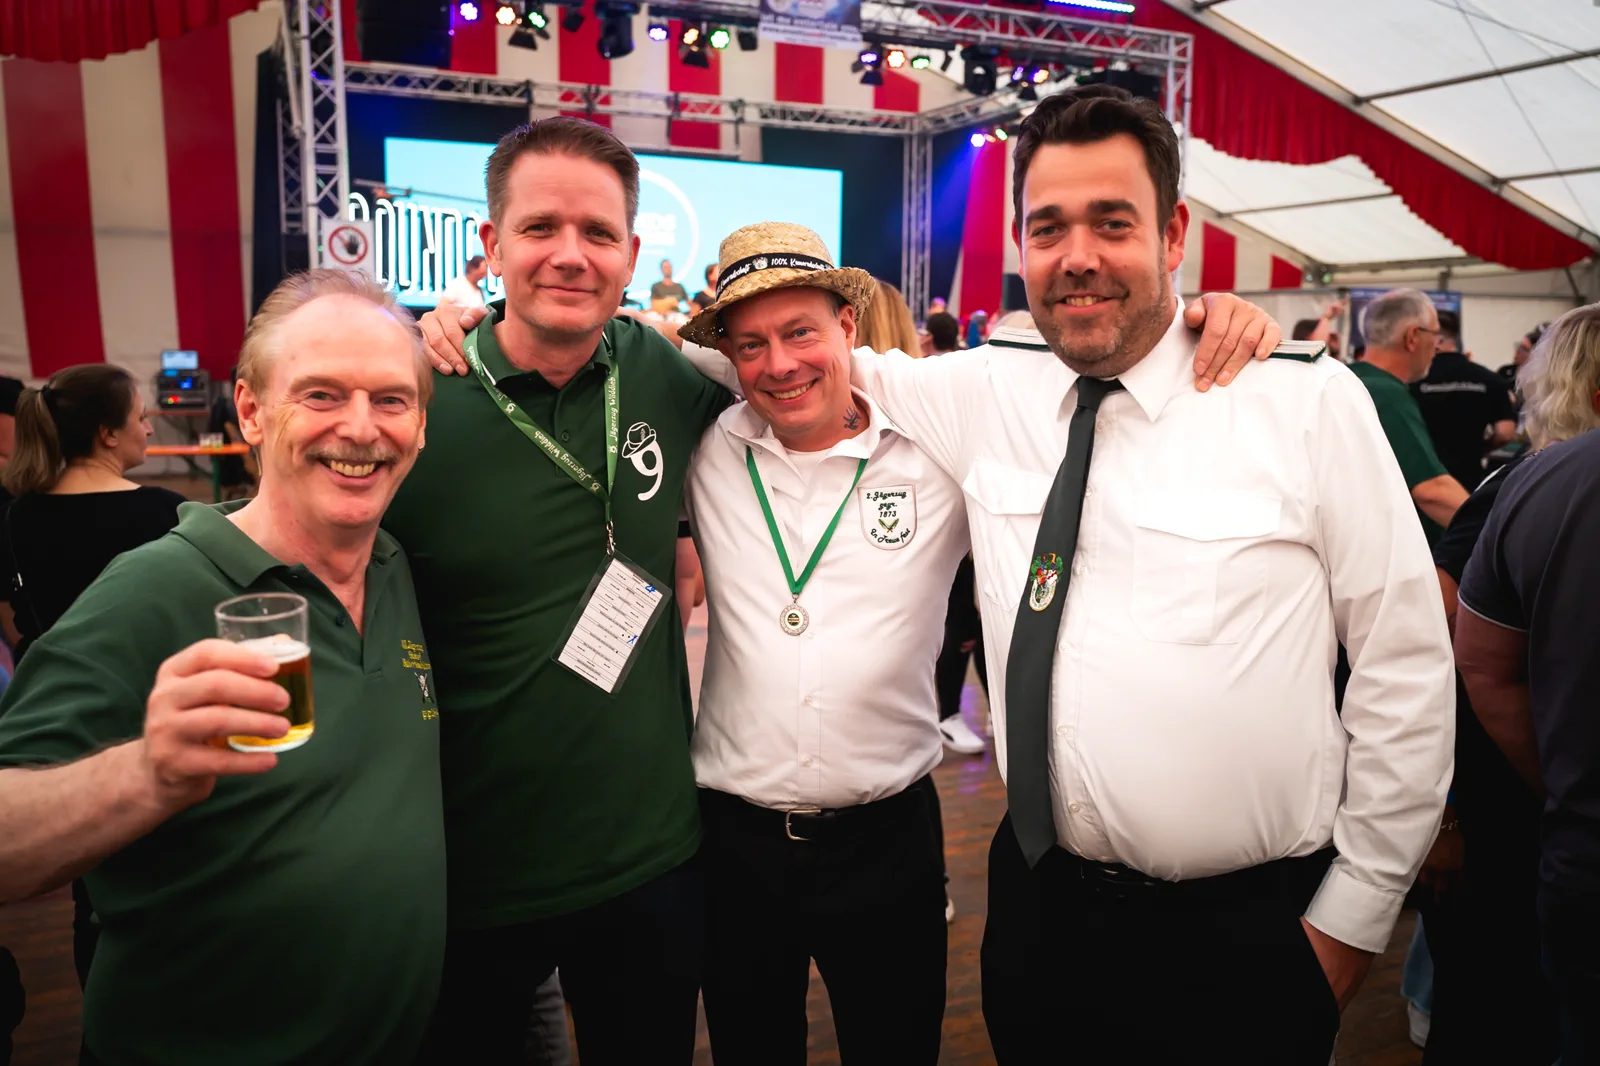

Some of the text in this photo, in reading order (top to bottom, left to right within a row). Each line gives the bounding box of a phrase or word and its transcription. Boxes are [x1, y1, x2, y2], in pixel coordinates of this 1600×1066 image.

[771, 257, 788, 267] 100%
[534, 430, 561, 458] Wilddieb
[560, 453, 593, 481] Jägerzug
[879, 510, 897, 518] 1873
